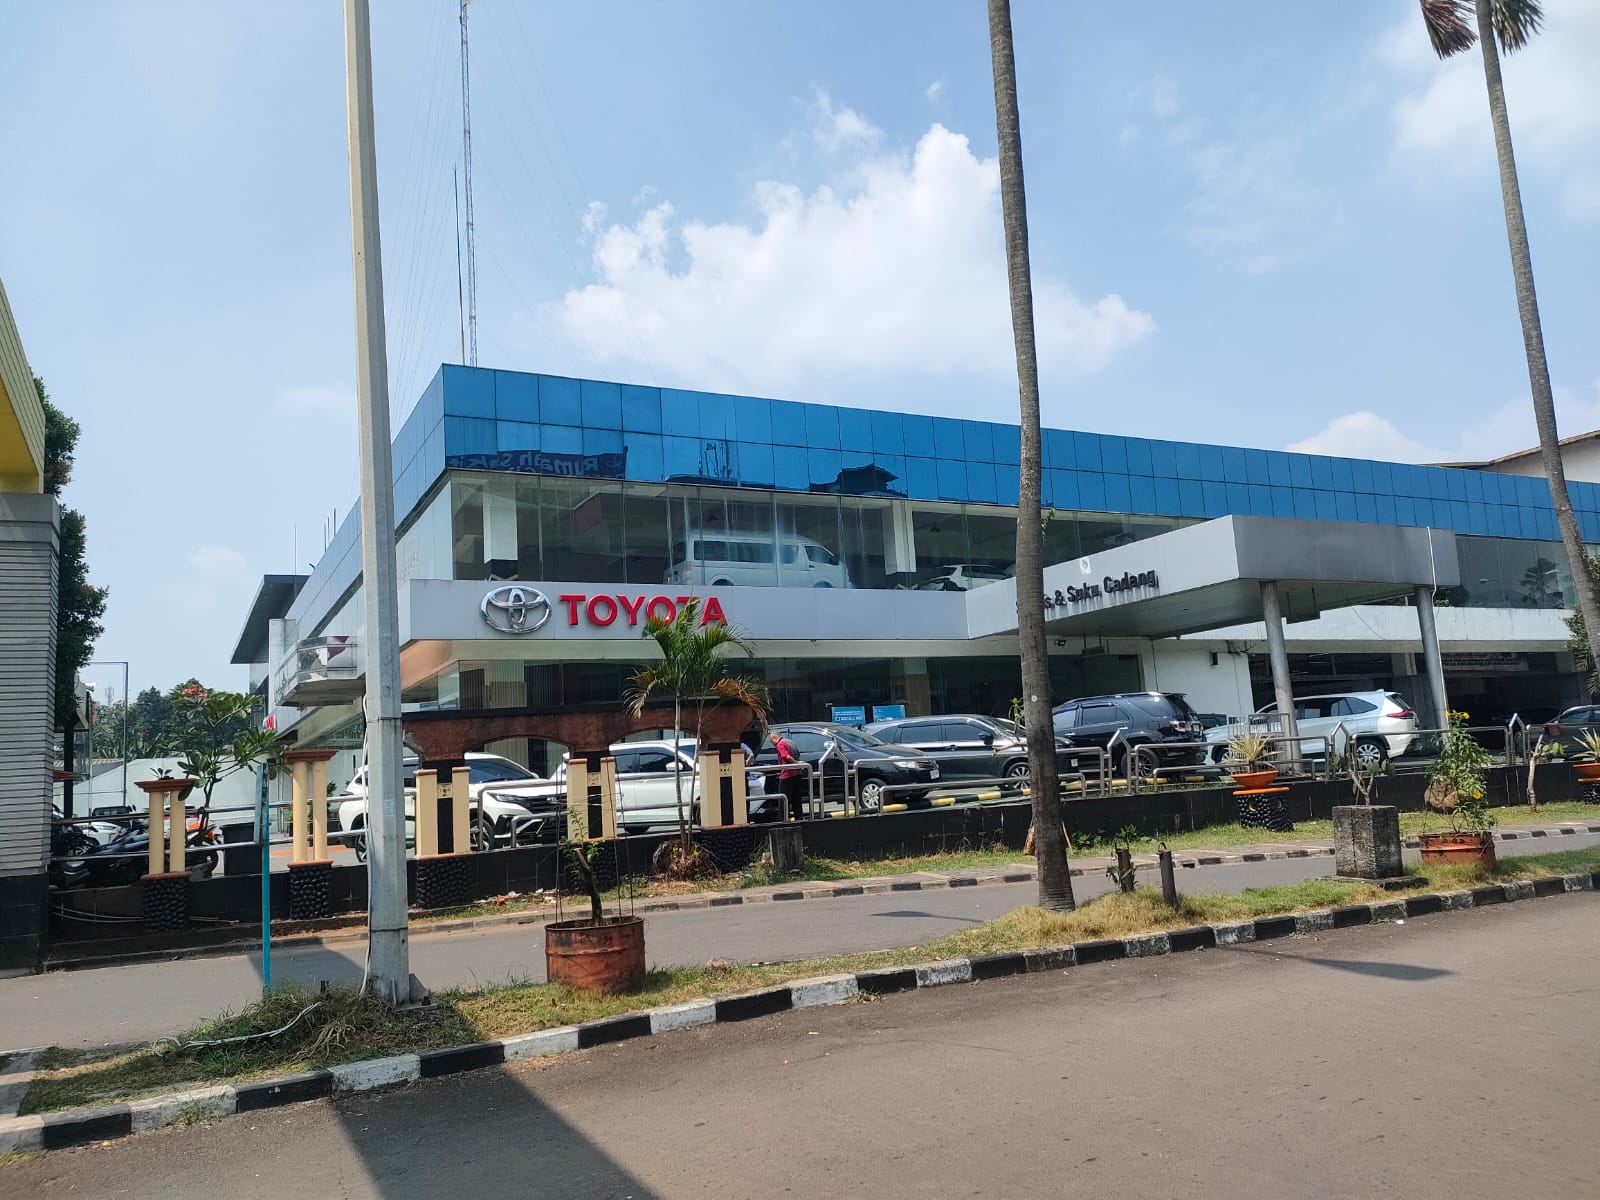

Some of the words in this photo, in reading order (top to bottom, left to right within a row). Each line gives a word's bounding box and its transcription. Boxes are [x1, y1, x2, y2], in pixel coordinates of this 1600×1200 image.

[1055, 589, 1067, 606] &
[1067, 582, 1101, 602] Suku
[1103, 570, 1159, 593] Cadang
